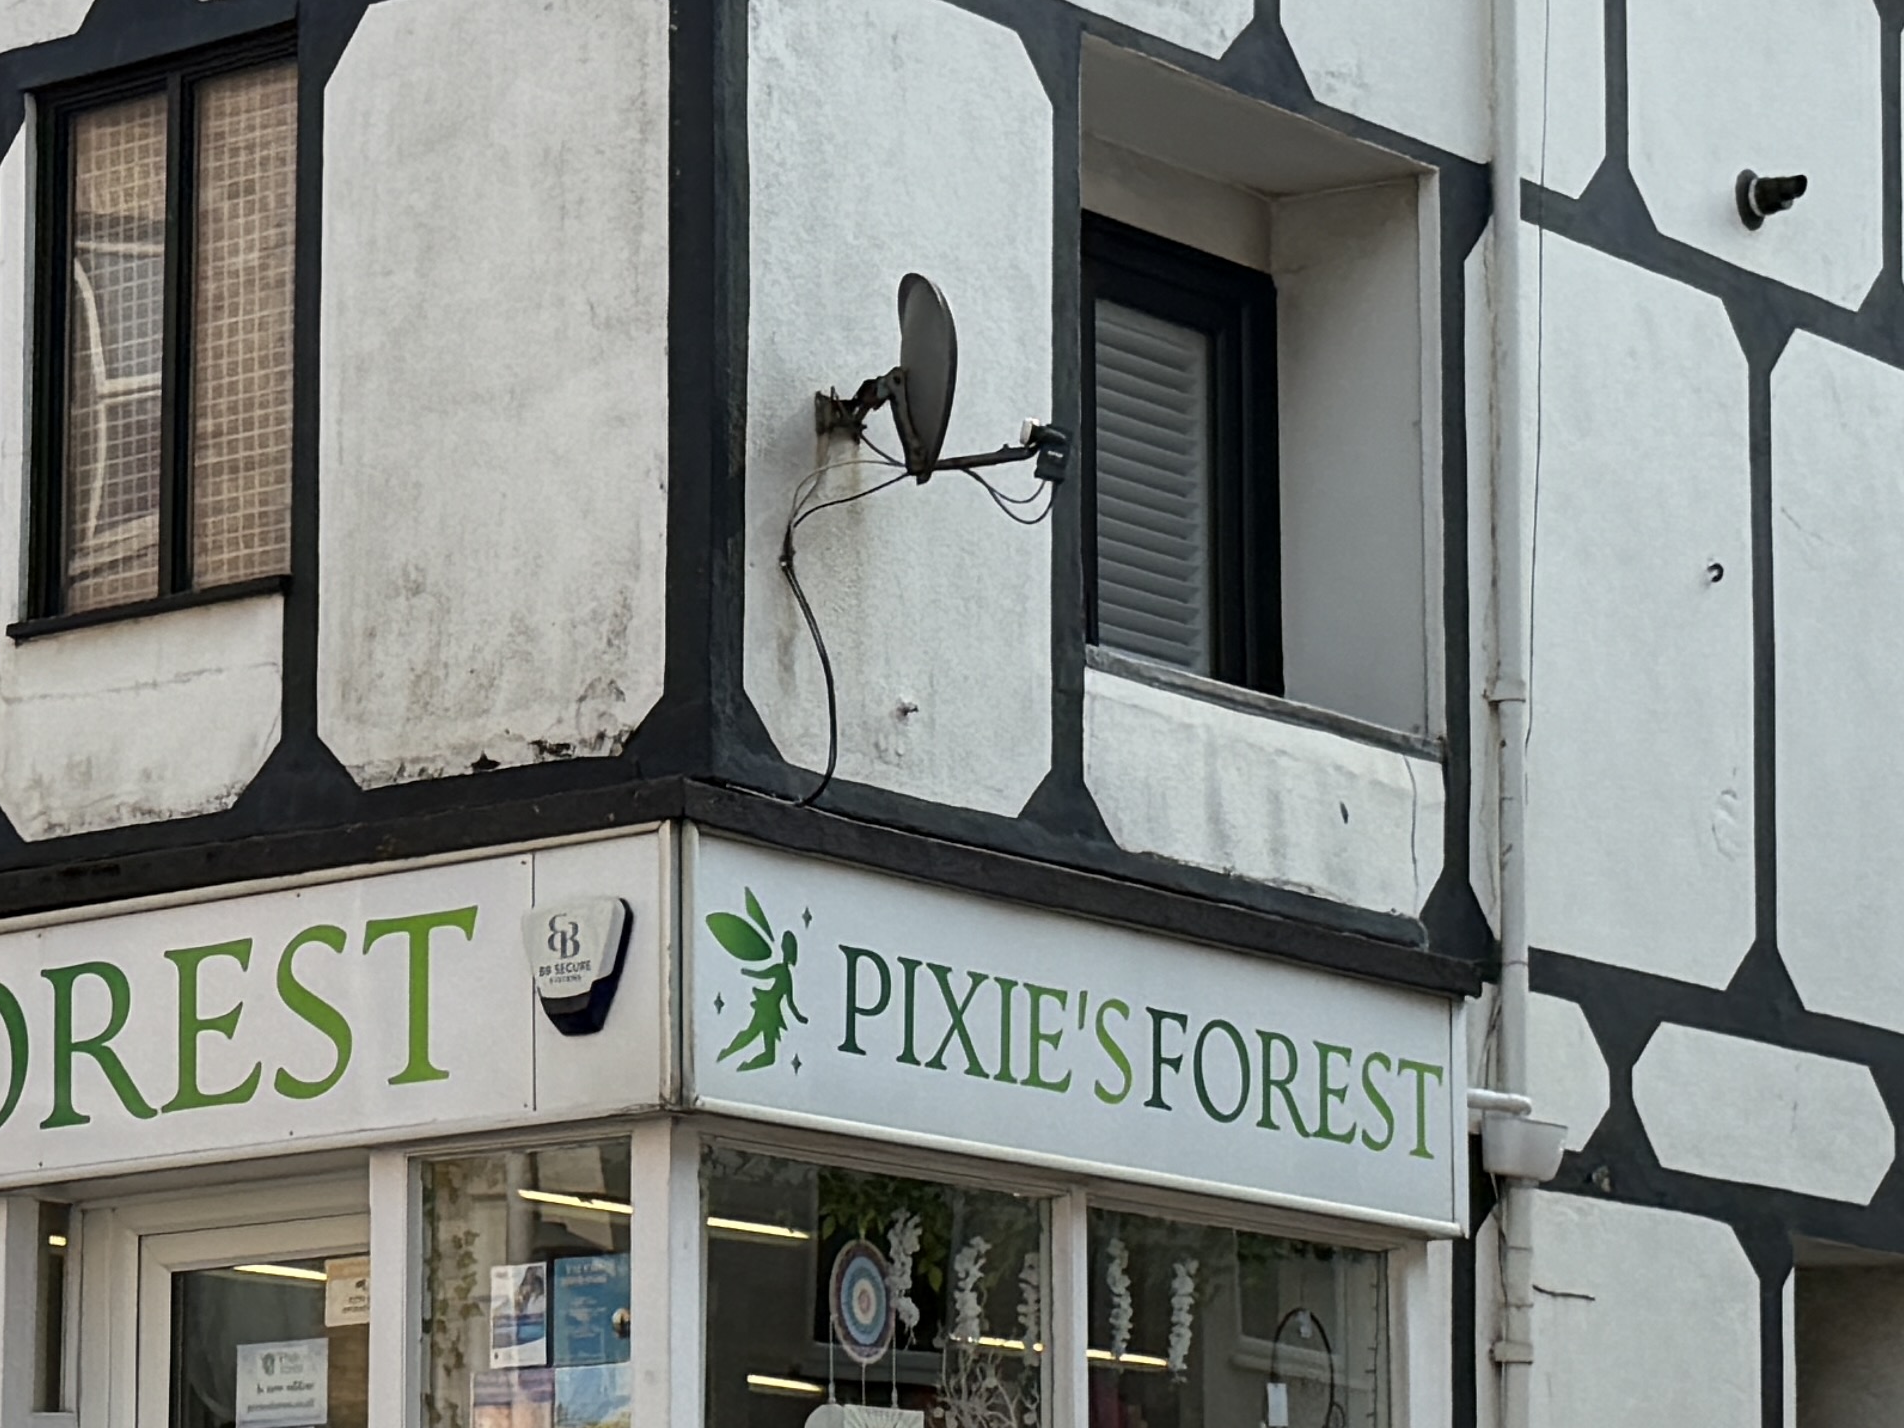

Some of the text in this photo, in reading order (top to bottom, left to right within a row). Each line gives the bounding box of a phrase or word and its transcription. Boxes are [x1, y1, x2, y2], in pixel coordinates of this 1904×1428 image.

[555, 960, 592, 975] SECURE
[838, 943, 1444, 1160] PIXIE'S FOREST
